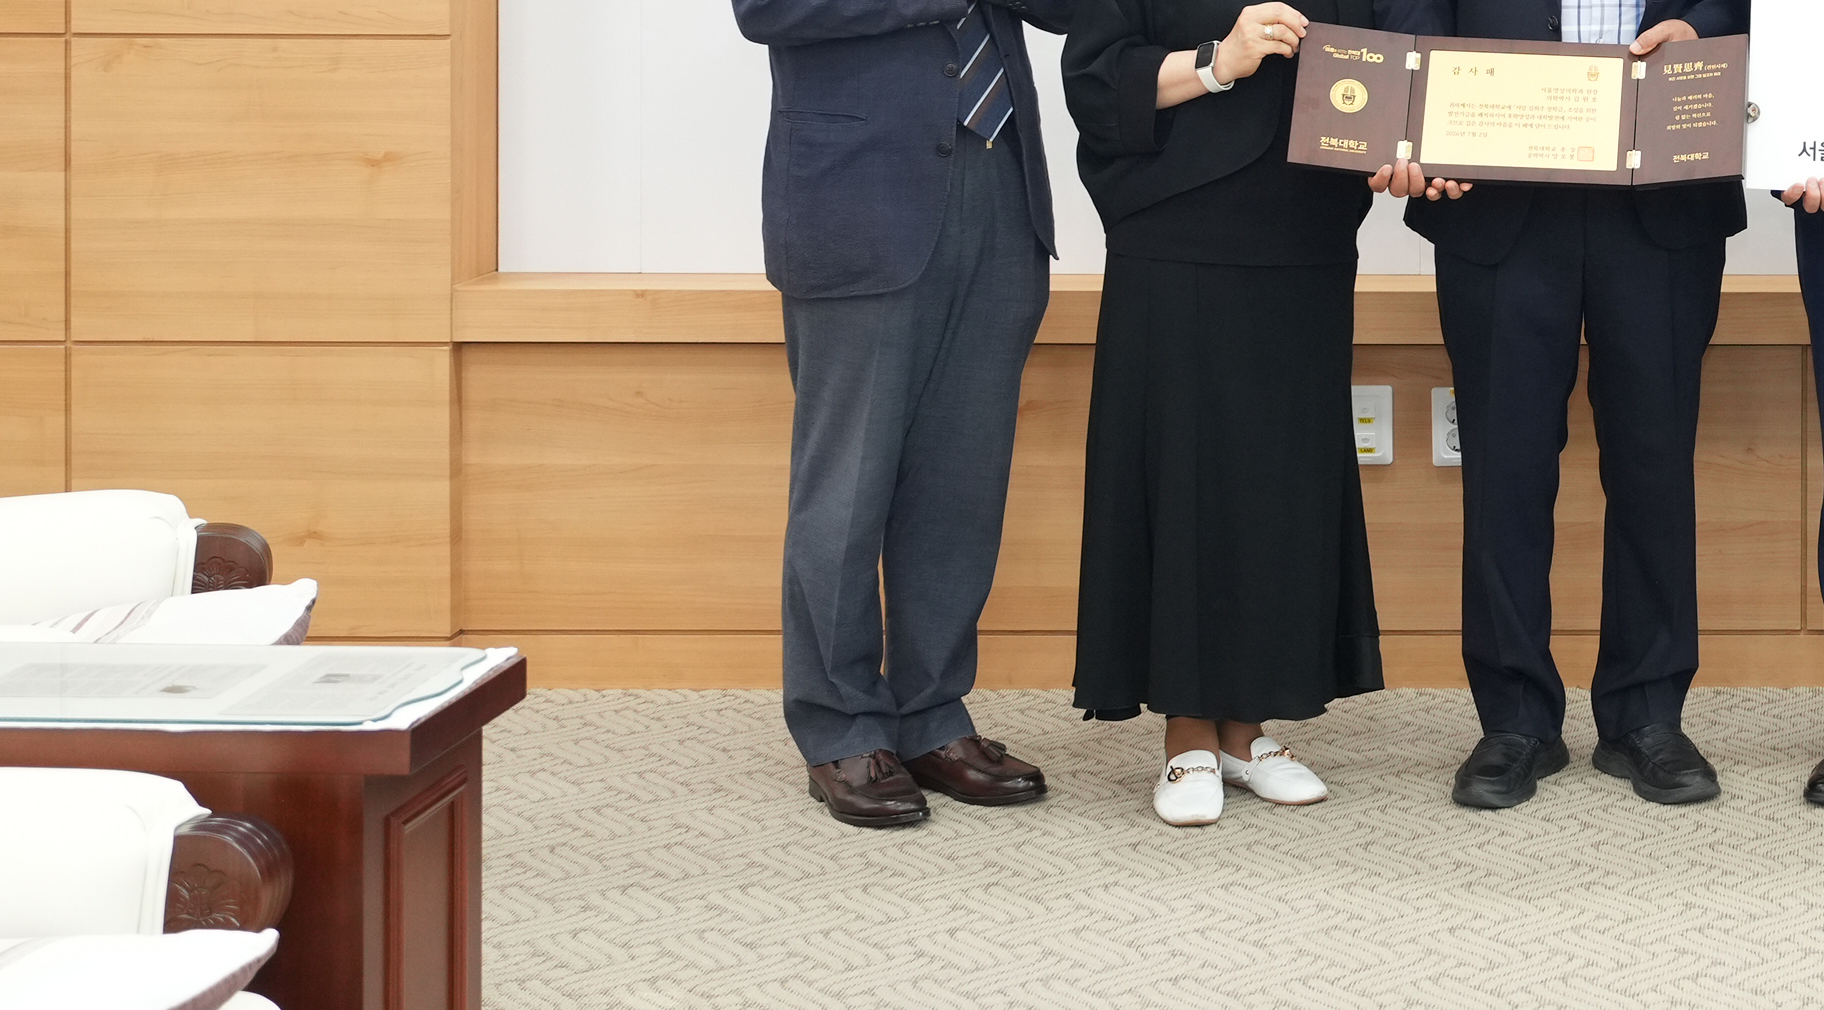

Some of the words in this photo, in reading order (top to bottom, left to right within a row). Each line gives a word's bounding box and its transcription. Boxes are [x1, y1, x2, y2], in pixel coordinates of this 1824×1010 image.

[1361, 48, 1384, 63] 100
[1320, 136, 1367, 150] 전북대학교
[1672, 152, 1709, 163] 전북대학교
